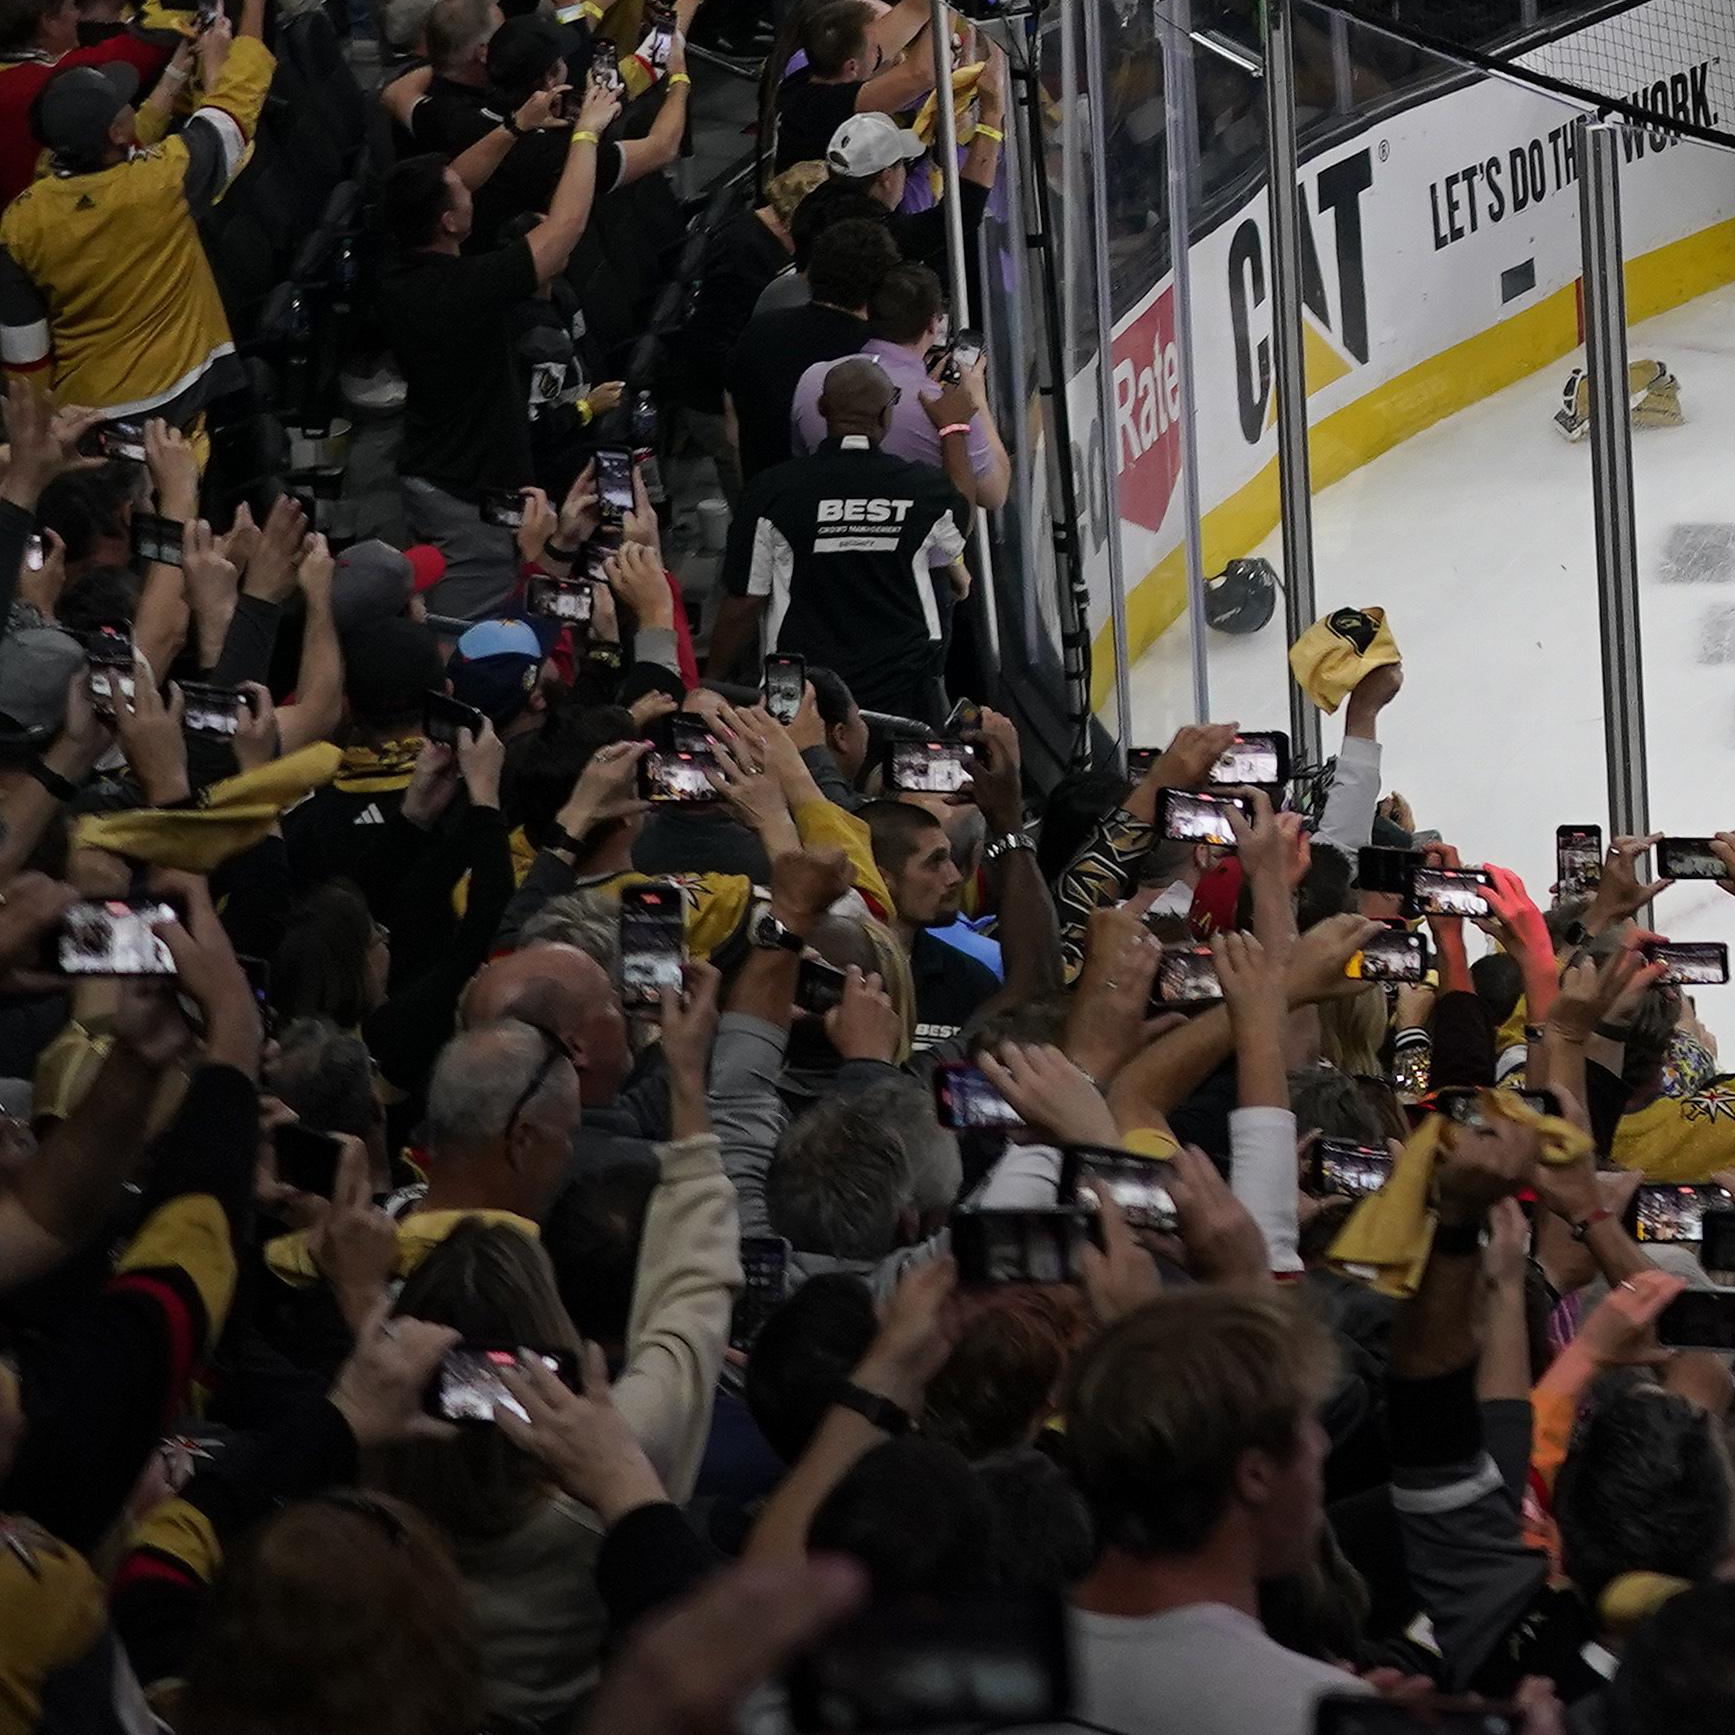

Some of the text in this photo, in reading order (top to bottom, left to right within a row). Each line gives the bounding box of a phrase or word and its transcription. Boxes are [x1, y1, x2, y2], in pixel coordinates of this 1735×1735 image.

[1430, 156, 1503, 251] LET'S
[1509, 139, 1546, 215] DO
[1548, 114, 1588, 192] TH
[817, 497, 916, 523] BEST
[914, 1022, 962, 1040] BEST
